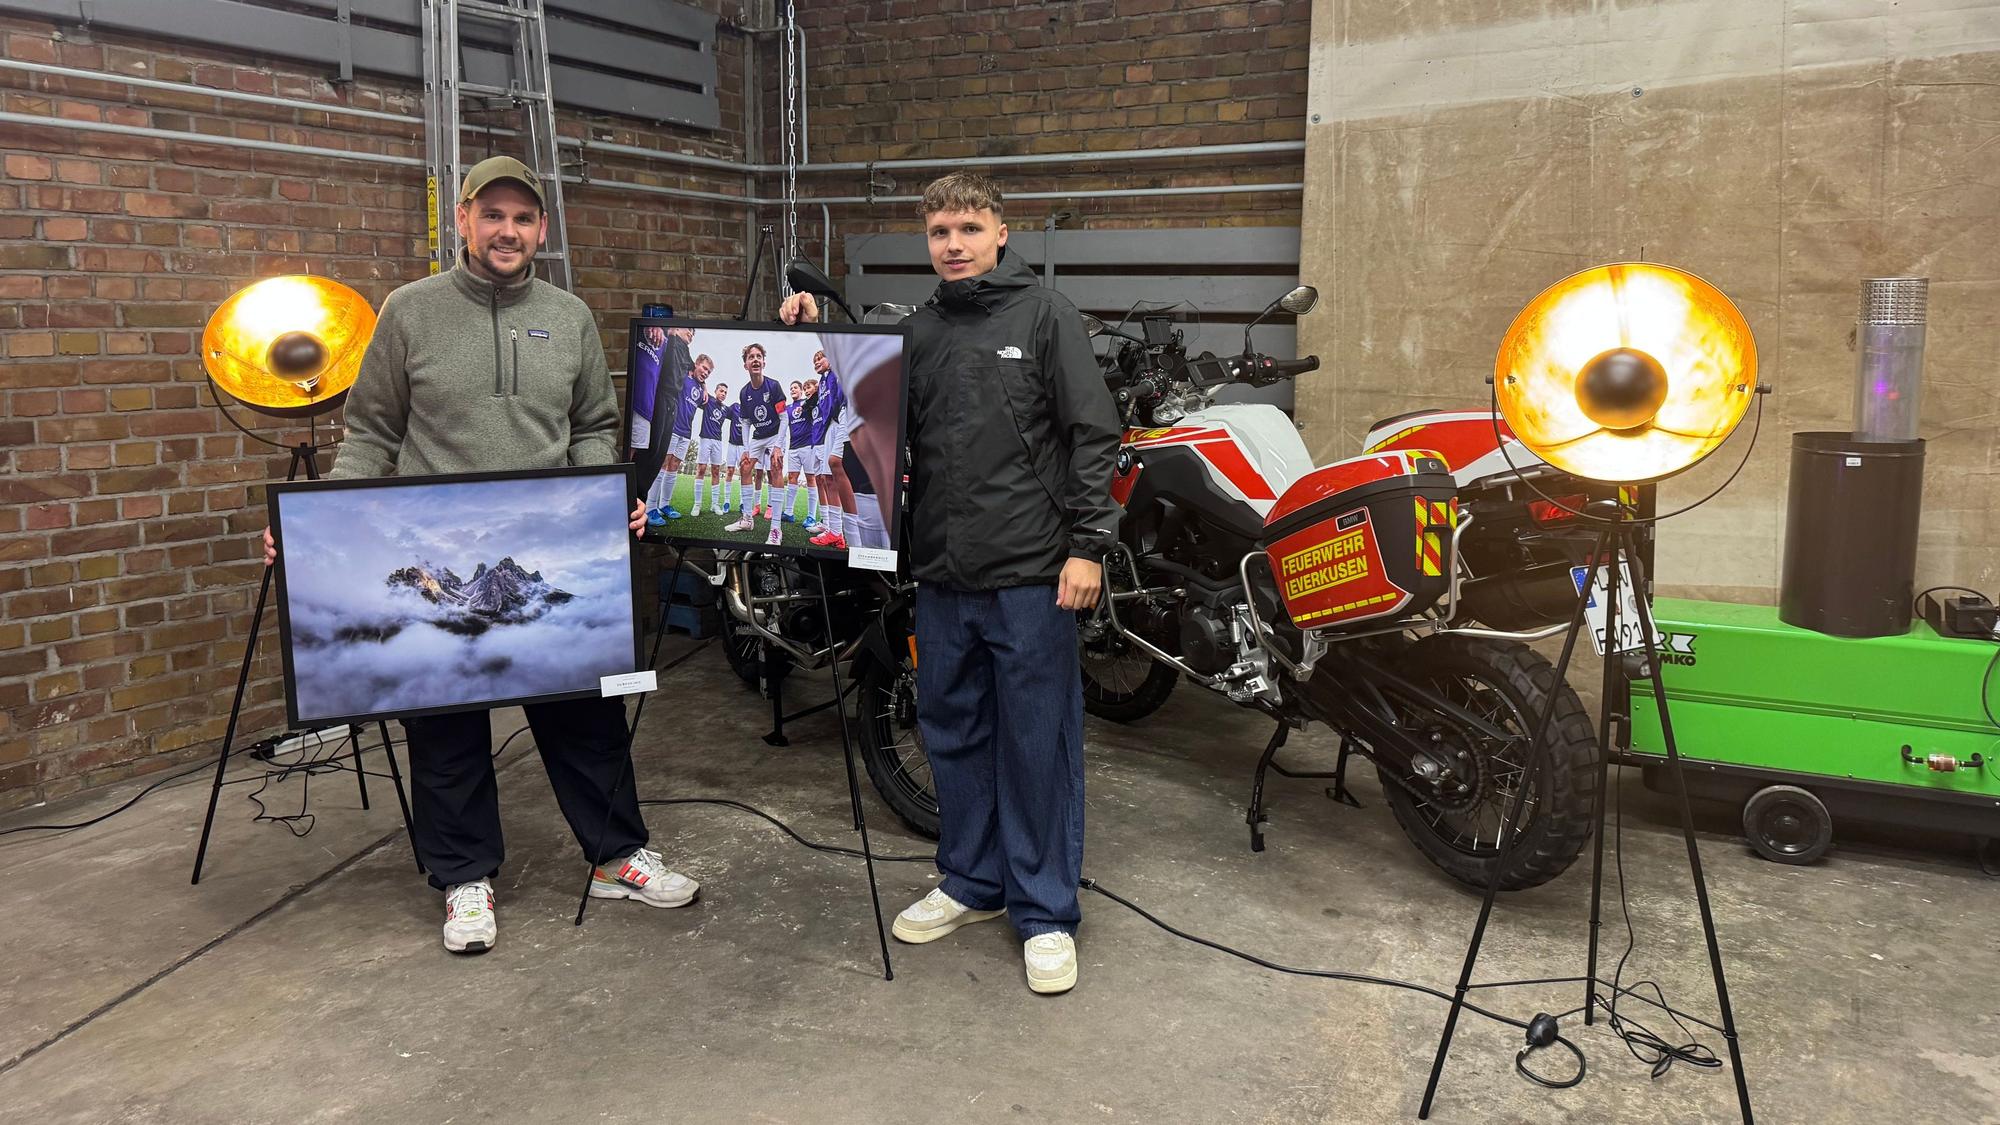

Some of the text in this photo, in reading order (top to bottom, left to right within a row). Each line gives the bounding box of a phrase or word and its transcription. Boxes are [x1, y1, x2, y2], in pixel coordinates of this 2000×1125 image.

[1342, 514, 1359, 526] BMW
[1281, 531, 1365, 577] FEUERWEHR
[1285, 555, 1368, 600] LEVERKUSEN
